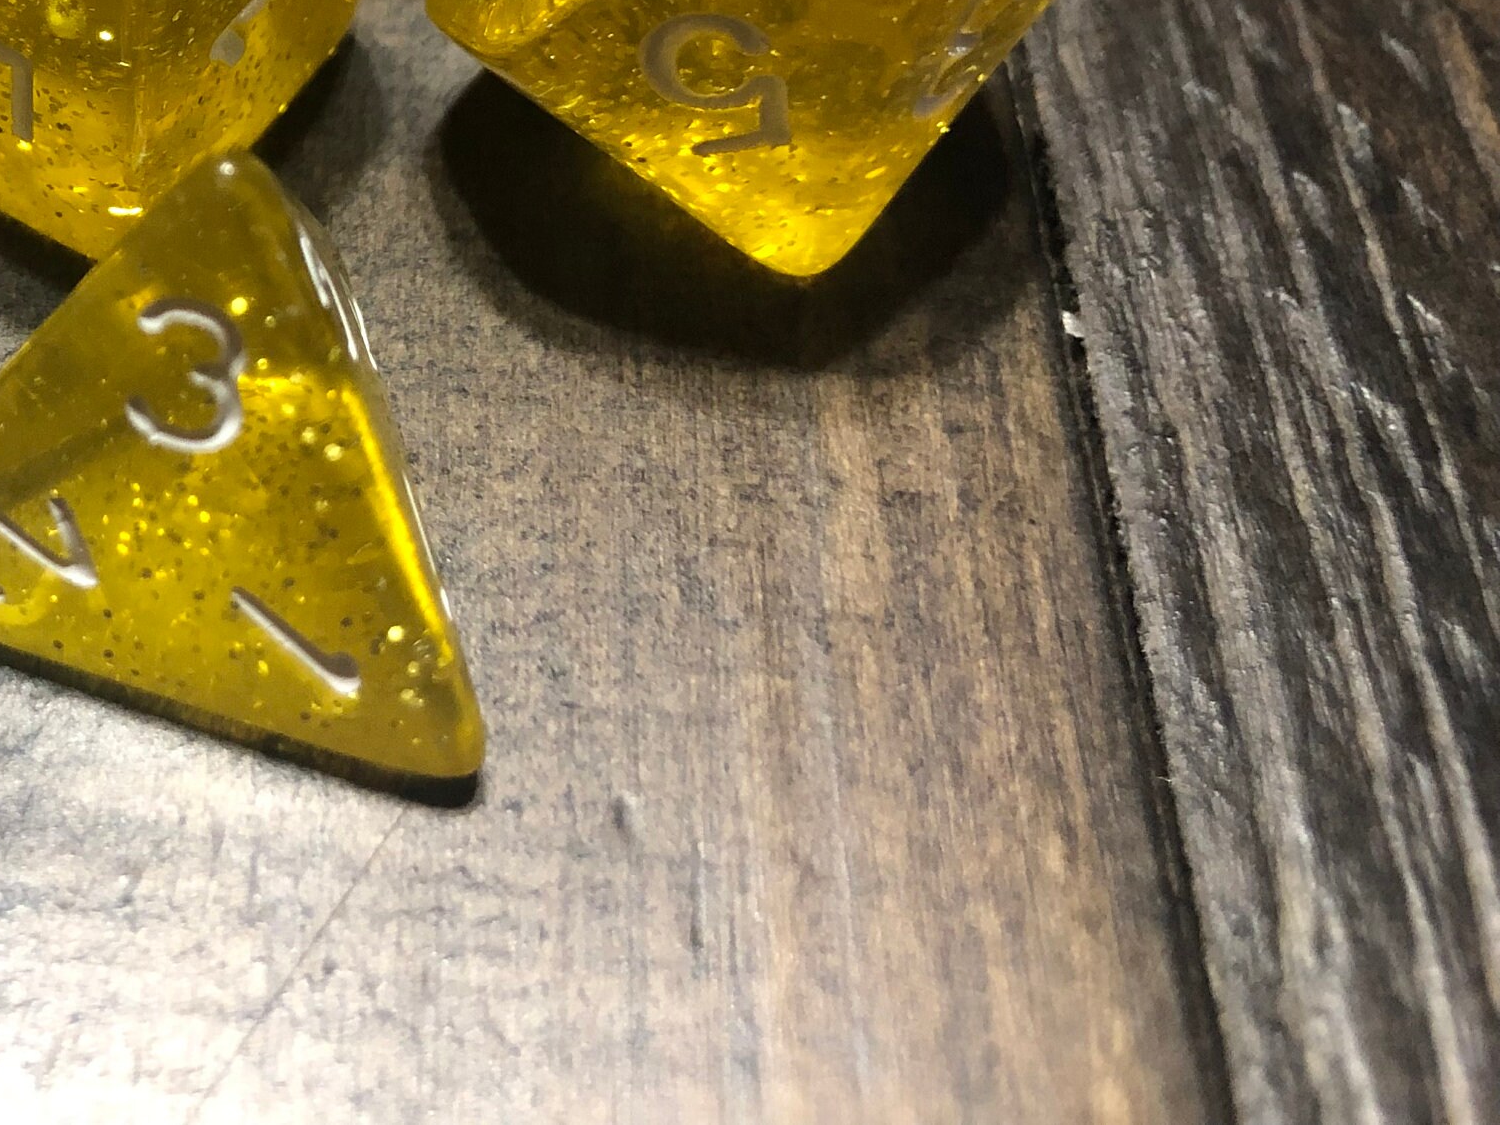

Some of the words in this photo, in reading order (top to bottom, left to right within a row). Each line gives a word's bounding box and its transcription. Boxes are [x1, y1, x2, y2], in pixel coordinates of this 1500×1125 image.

[637, 12, 791, 157] 5
[125, 297, 247, 454] 3
[229, 586, 362, 695] 1
